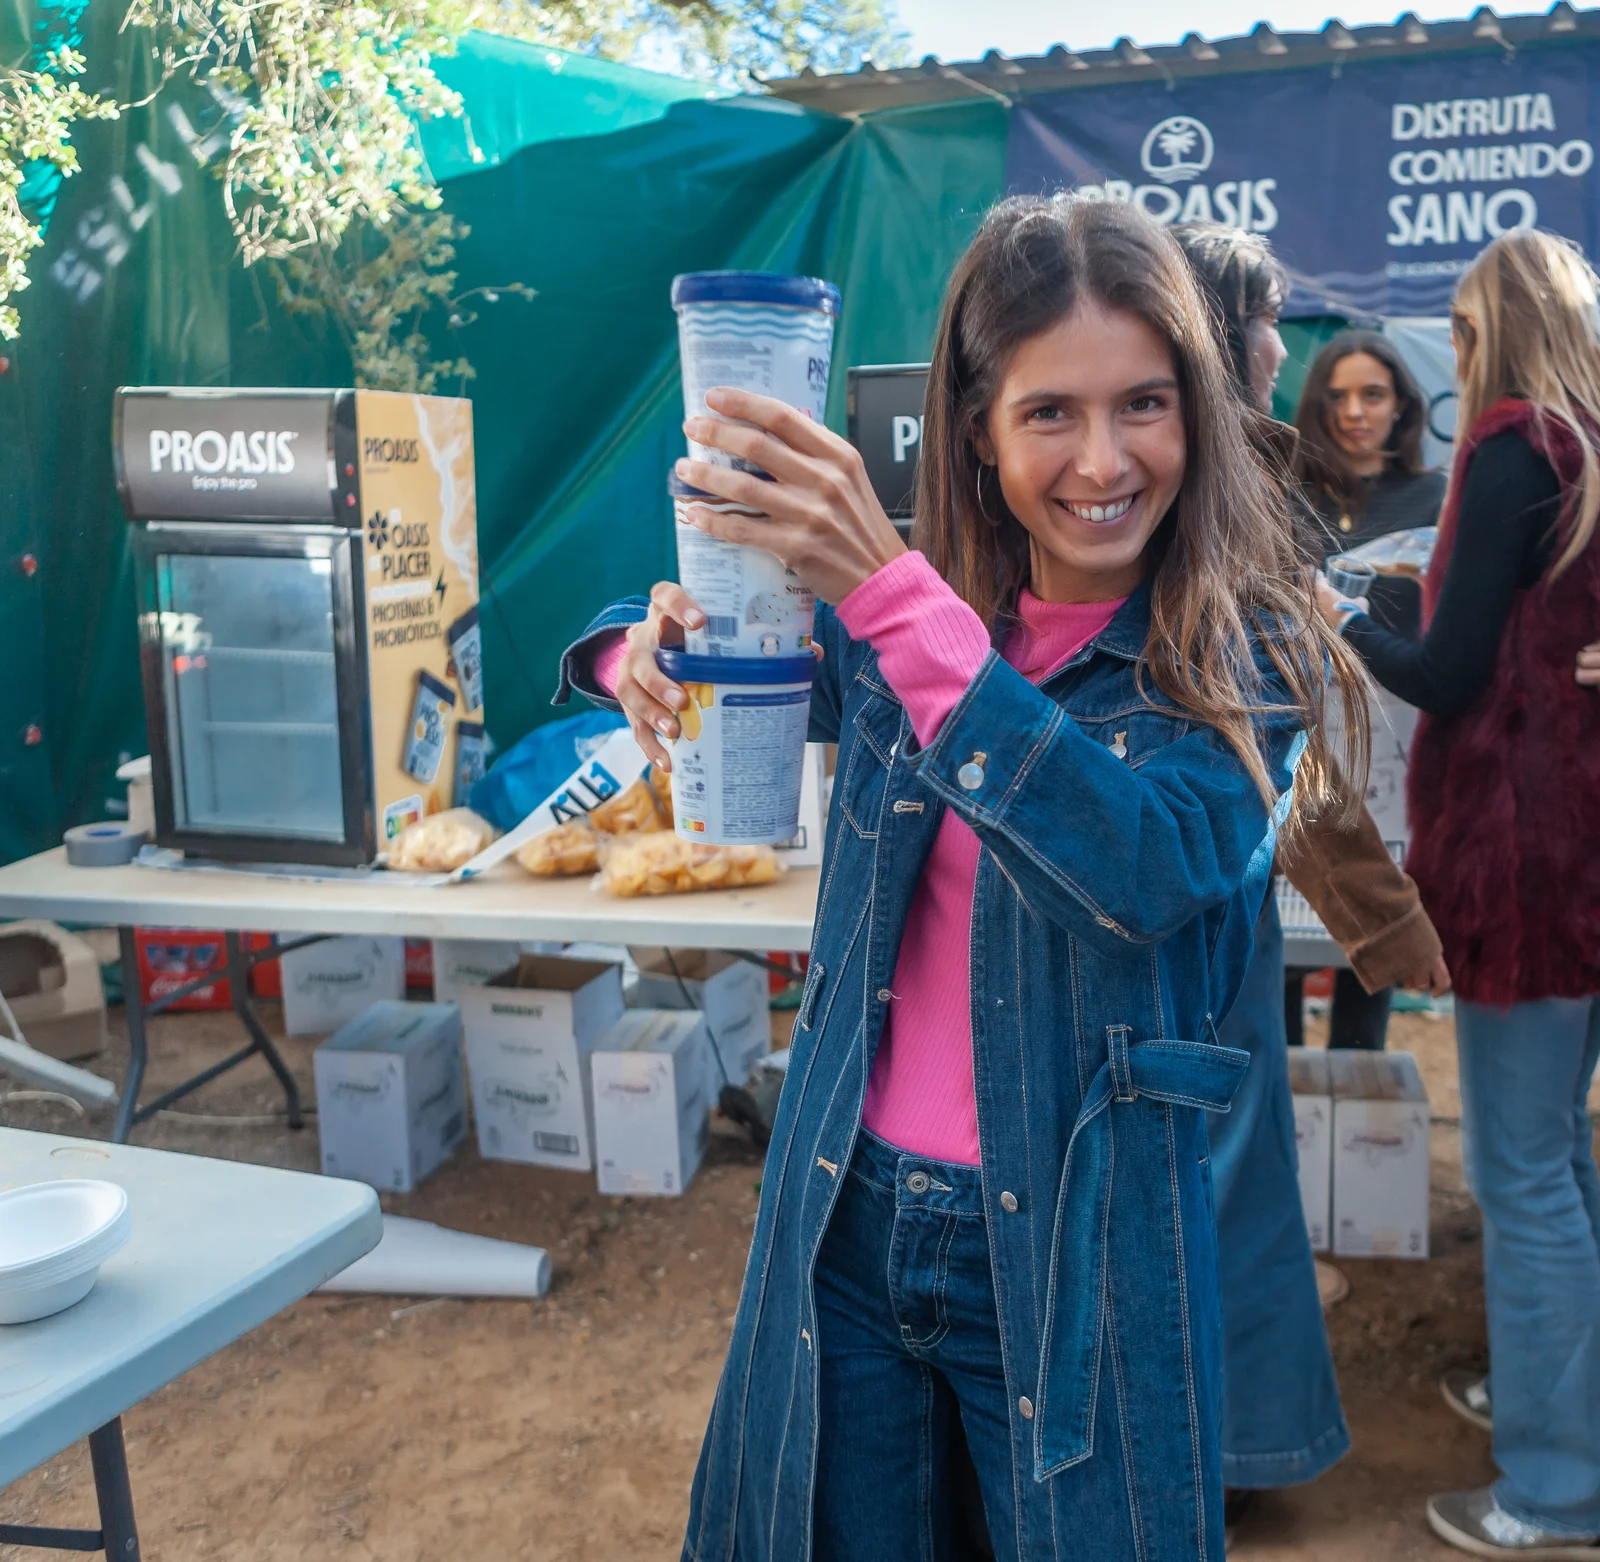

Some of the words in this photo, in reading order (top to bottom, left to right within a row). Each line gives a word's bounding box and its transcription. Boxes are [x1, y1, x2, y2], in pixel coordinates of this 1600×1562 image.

[1391, 93, 1556, 141] DISFRUTA
[1388, 139, 1594, 185] COMIENDO
[1386, 188, 1538, 247] SANO
[149, 430, 296, 475] PROASIS
[364, 437, 419, 463] PROASIS
[391, 522, 430, 549] OASIS
[382, 552, 432, 580] PLACER
